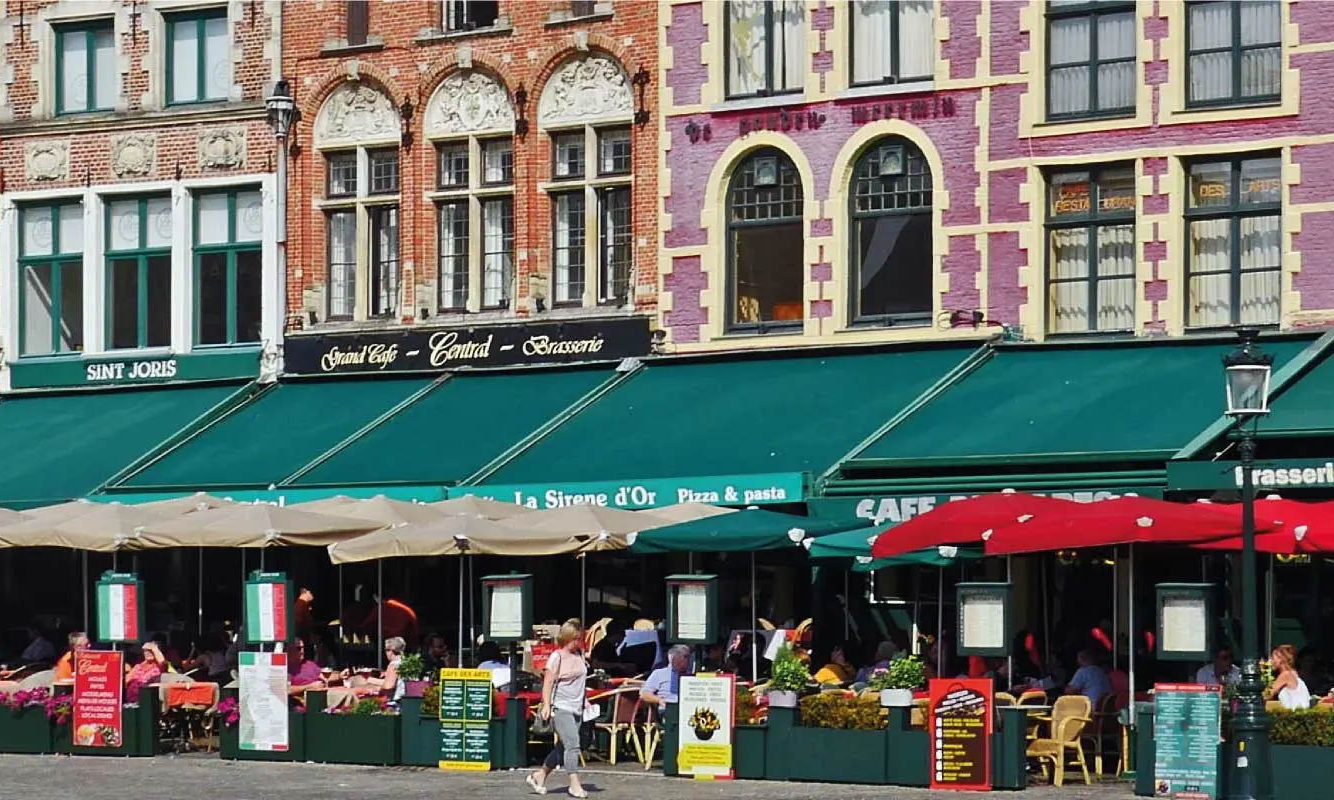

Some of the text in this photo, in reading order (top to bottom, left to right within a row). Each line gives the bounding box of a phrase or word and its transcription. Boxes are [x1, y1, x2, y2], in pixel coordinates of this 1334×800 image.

[321, 346, 367, 371] Grand
[428, 332, 493, 367] Central
[522, 334, 604, 356] Brasserie
[87, 360, 177, 380] SINT JORIS
[514, 486, 656, 509] La Sirene d'Or
[678, 486, 786, 504] Pizza & pasta
